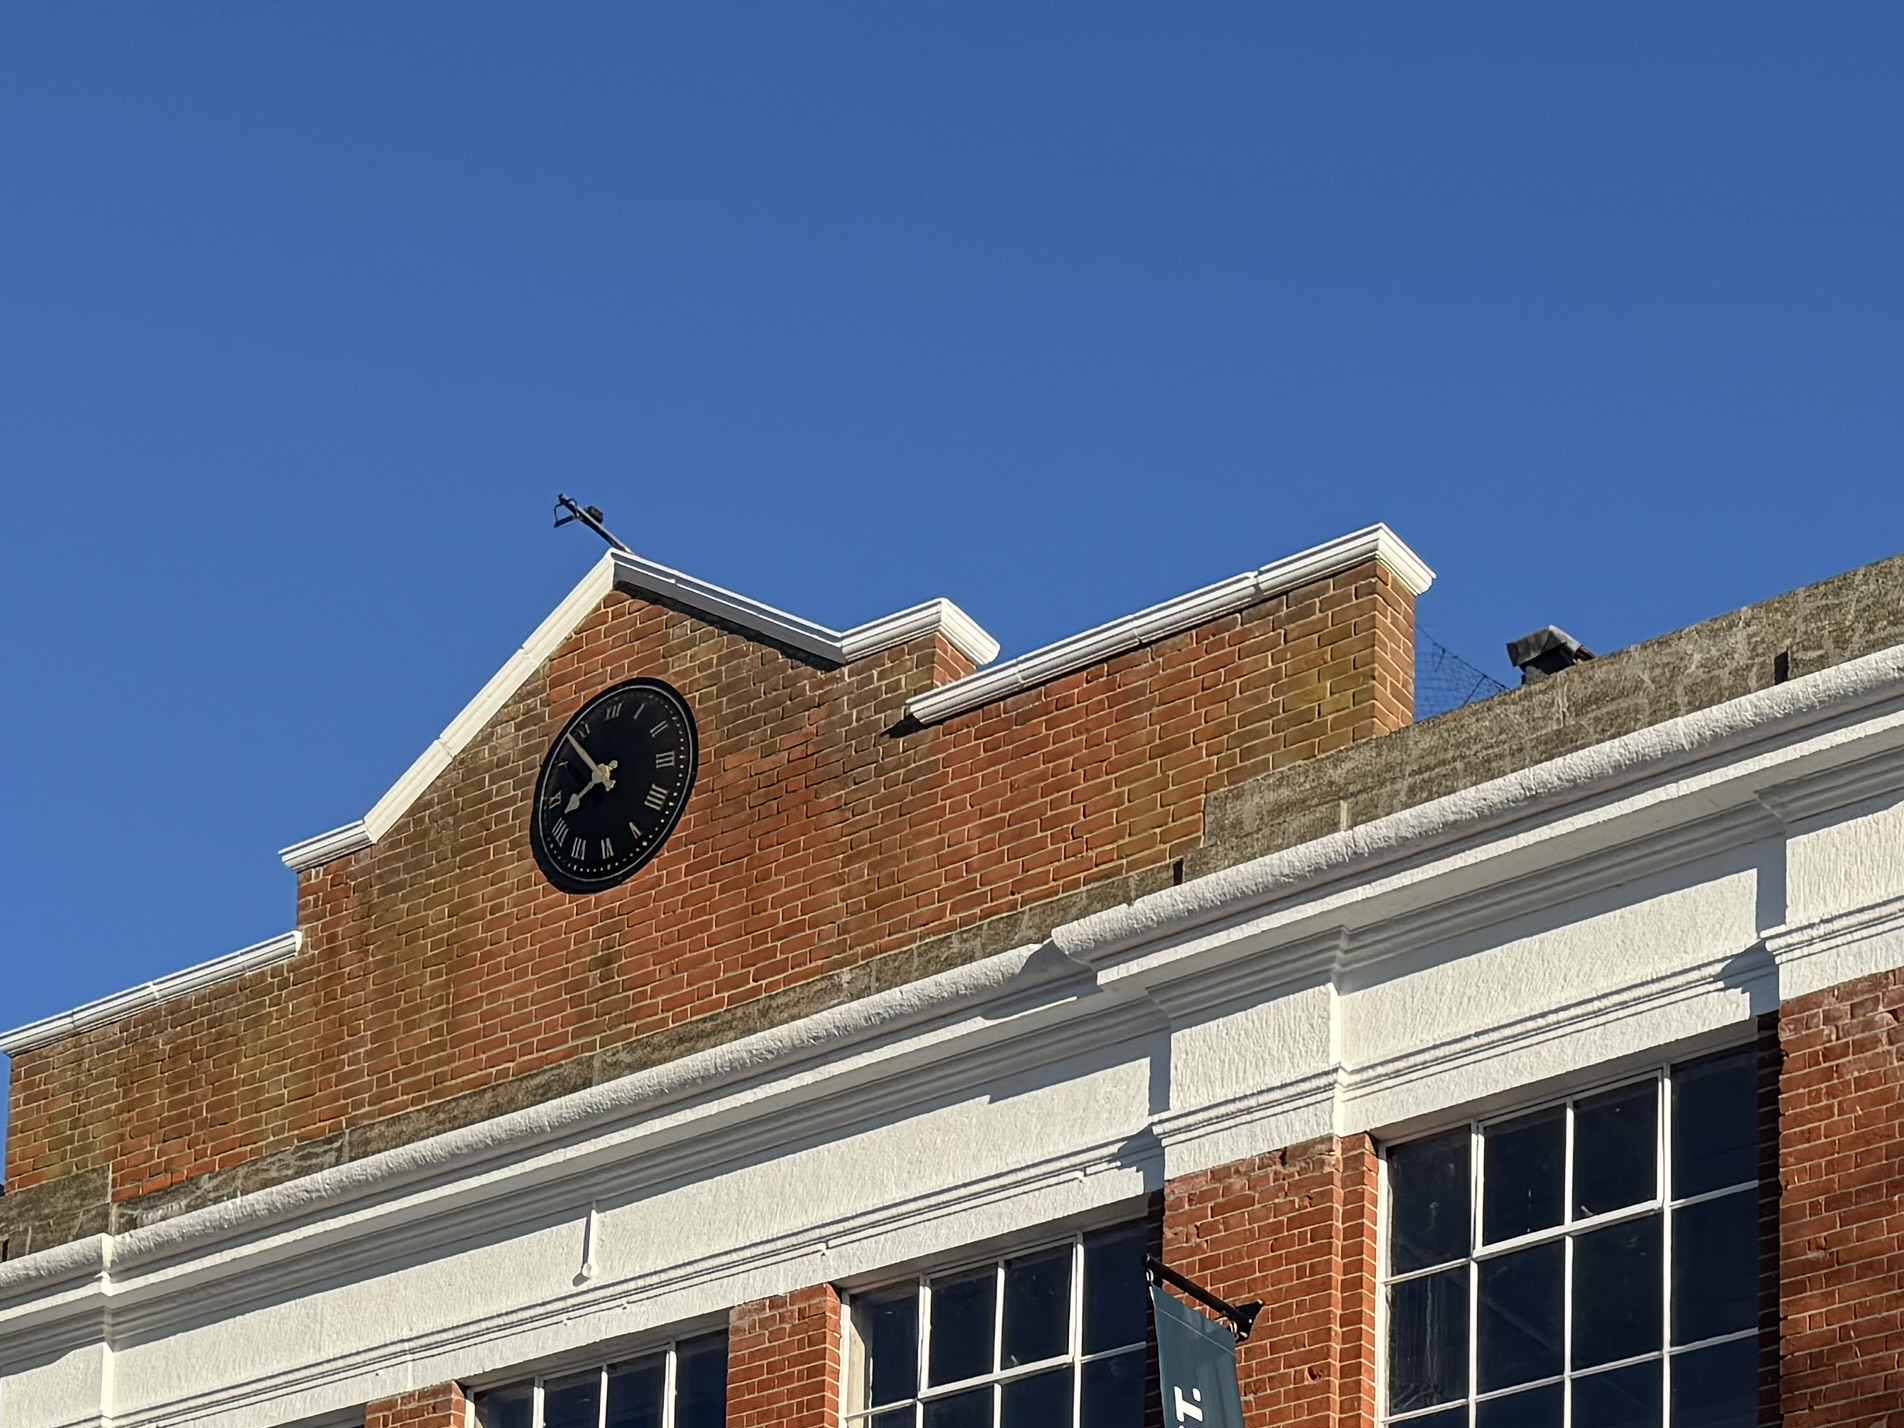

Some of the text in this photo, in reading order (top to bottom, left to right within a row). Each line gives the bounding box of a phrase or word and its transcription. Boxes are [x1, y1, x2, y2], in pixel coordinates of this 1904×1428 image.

[649, 720, 669, 738] II
[655, 751, 675, 769] III
[644, 784, 669, 811] IIII
